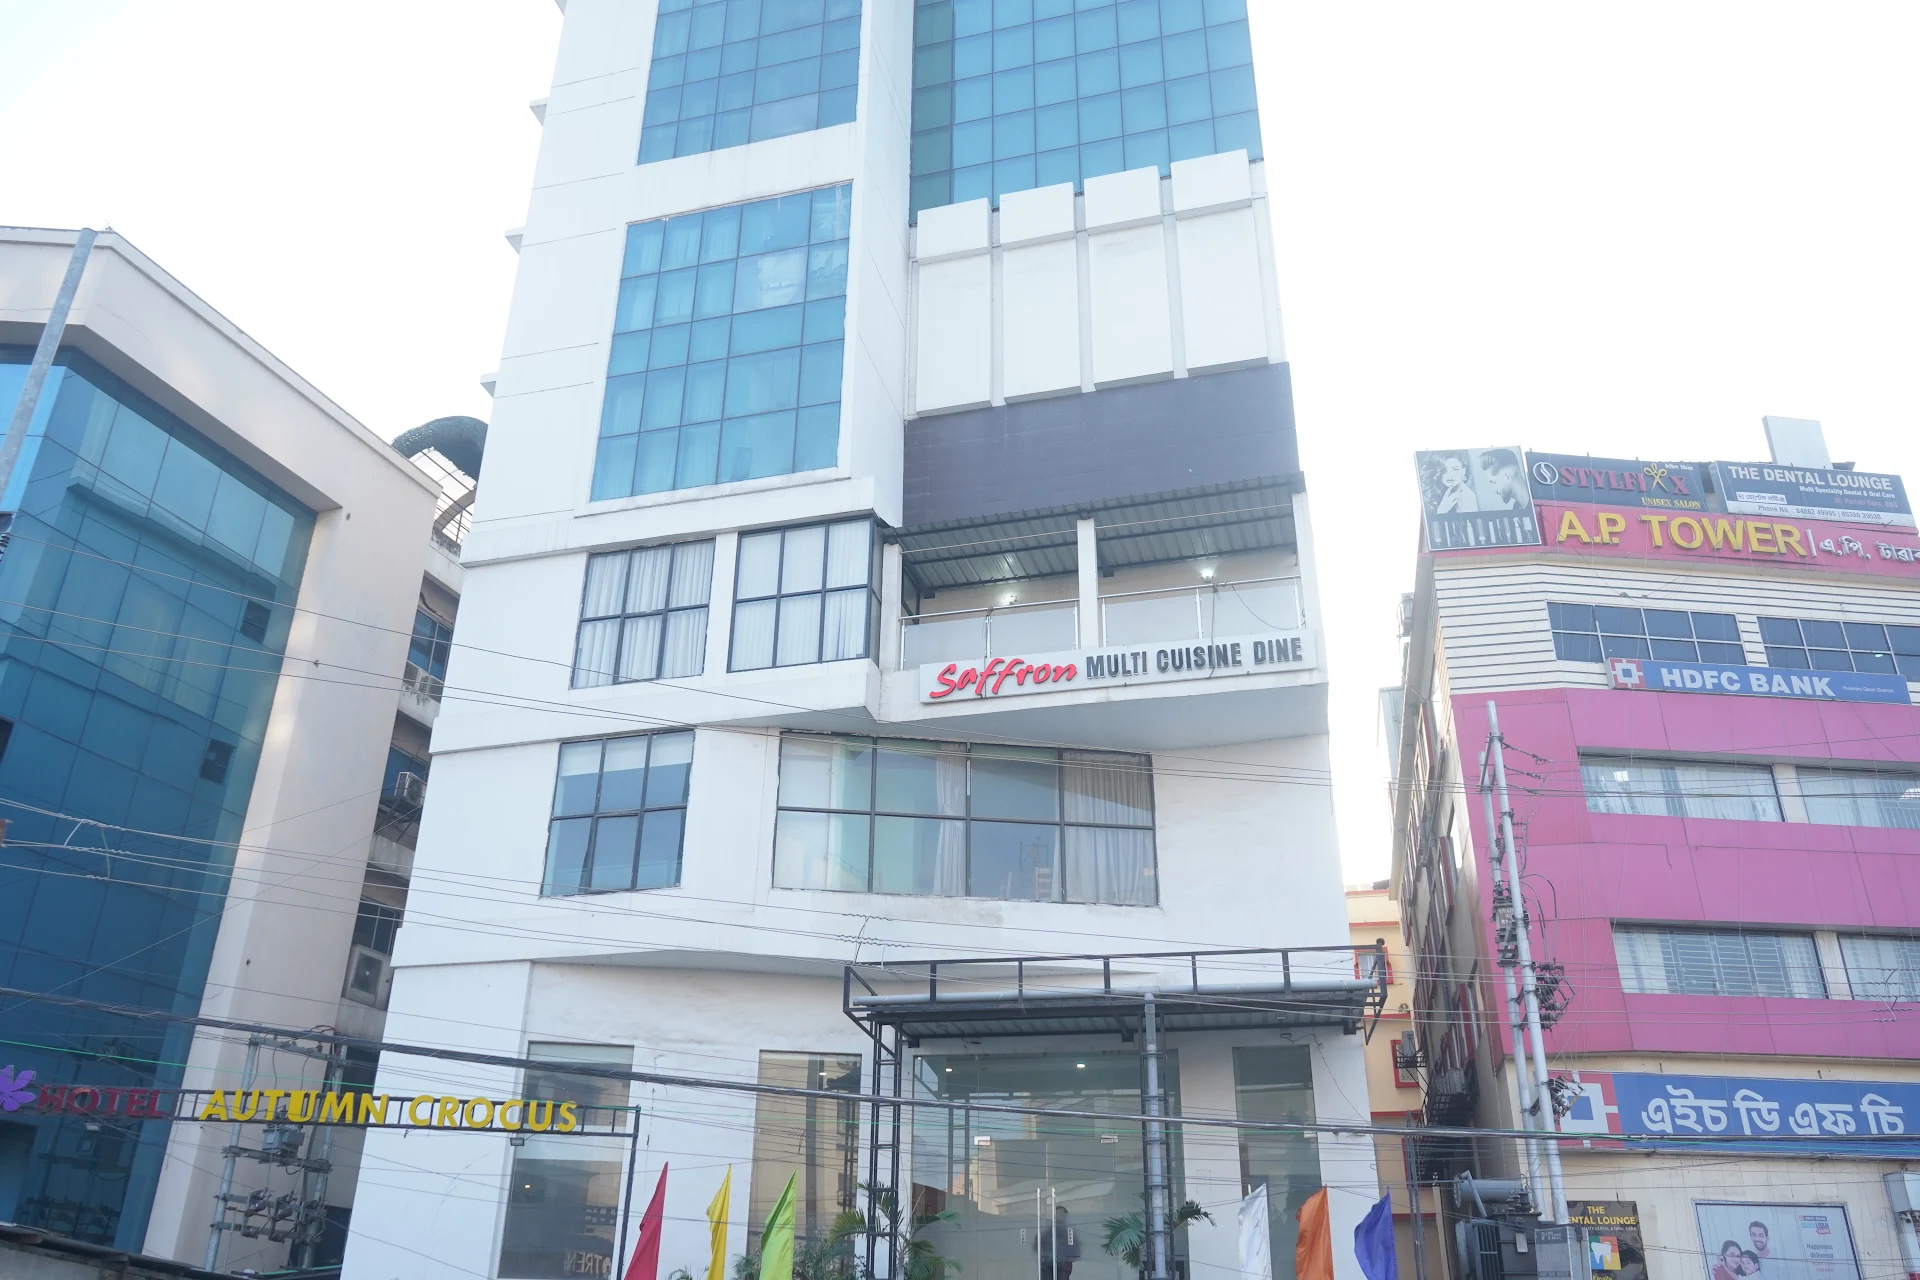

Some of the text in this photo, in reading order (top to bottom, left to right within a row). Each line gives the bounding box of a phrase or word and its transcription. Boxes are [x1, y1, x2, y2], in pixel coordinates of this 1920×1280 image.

[1728, 466, 1892, 490] THE DENTAL LOUNGE
[1815, 486, 1842, 495] Speciality
[1641, 497, 1701, 509] UNISEX SALON
[1757, 505, 1778, 513] Phone
[1637, 514, 1808, 557] TOWER
[1086, 637, 1303, 680] MULTI CUISINE DINE
[929, 658, 1077, 698] Saffron
[1660, 668, 1836, 697] HDFC BANK
[37, 1084, 577, 1132] HOTEL AUTUMN CROCUS
[1732, 1088, 1781, 1136] ডি
[1788, 1102, 1856, 1135] এফ
[1587, 1206, 1605, 1214] THE
[1597, 1216, 1636, 1225] LOUNGE
